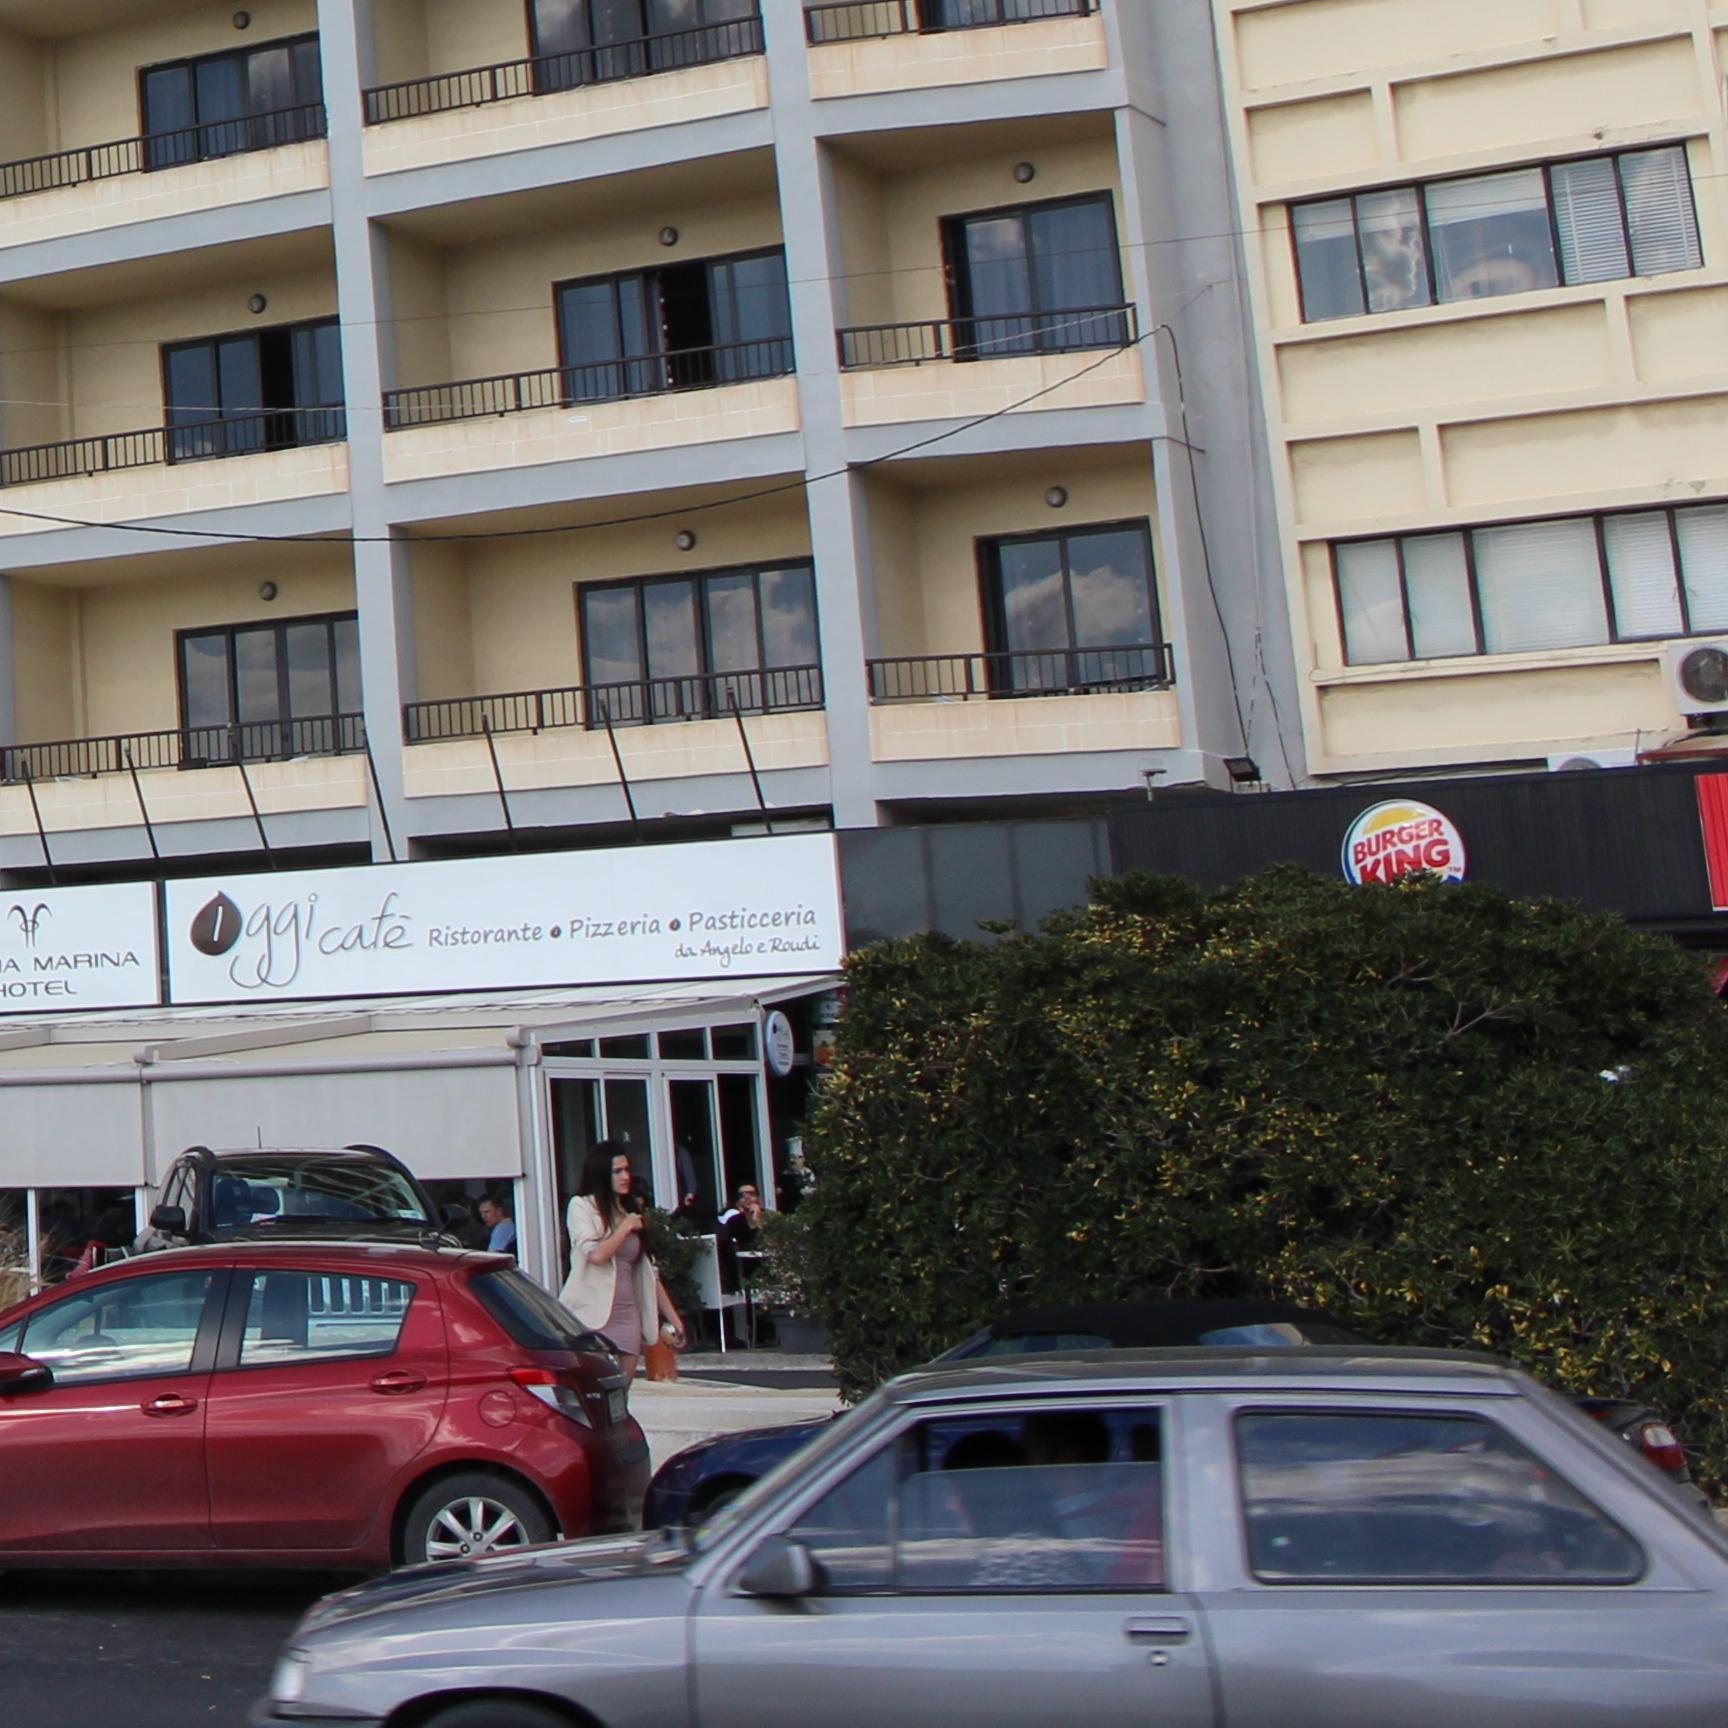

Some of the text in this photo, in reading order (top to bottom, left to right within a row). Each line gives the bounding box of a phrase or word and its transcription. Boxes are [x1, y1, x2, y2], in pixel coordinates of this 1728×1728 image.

[1353, 818, 1444, 865] BURGER
[1360, 838, 1450, 883] KING
[428, 922, 543, 947] Ristorante
[569, 913, 661, 939] Pizzeria
[688, 903, 817, 932] Pasticceria
[33, 951, 140, 972] MARINA
[700, 935, 753, 969] Angelo
